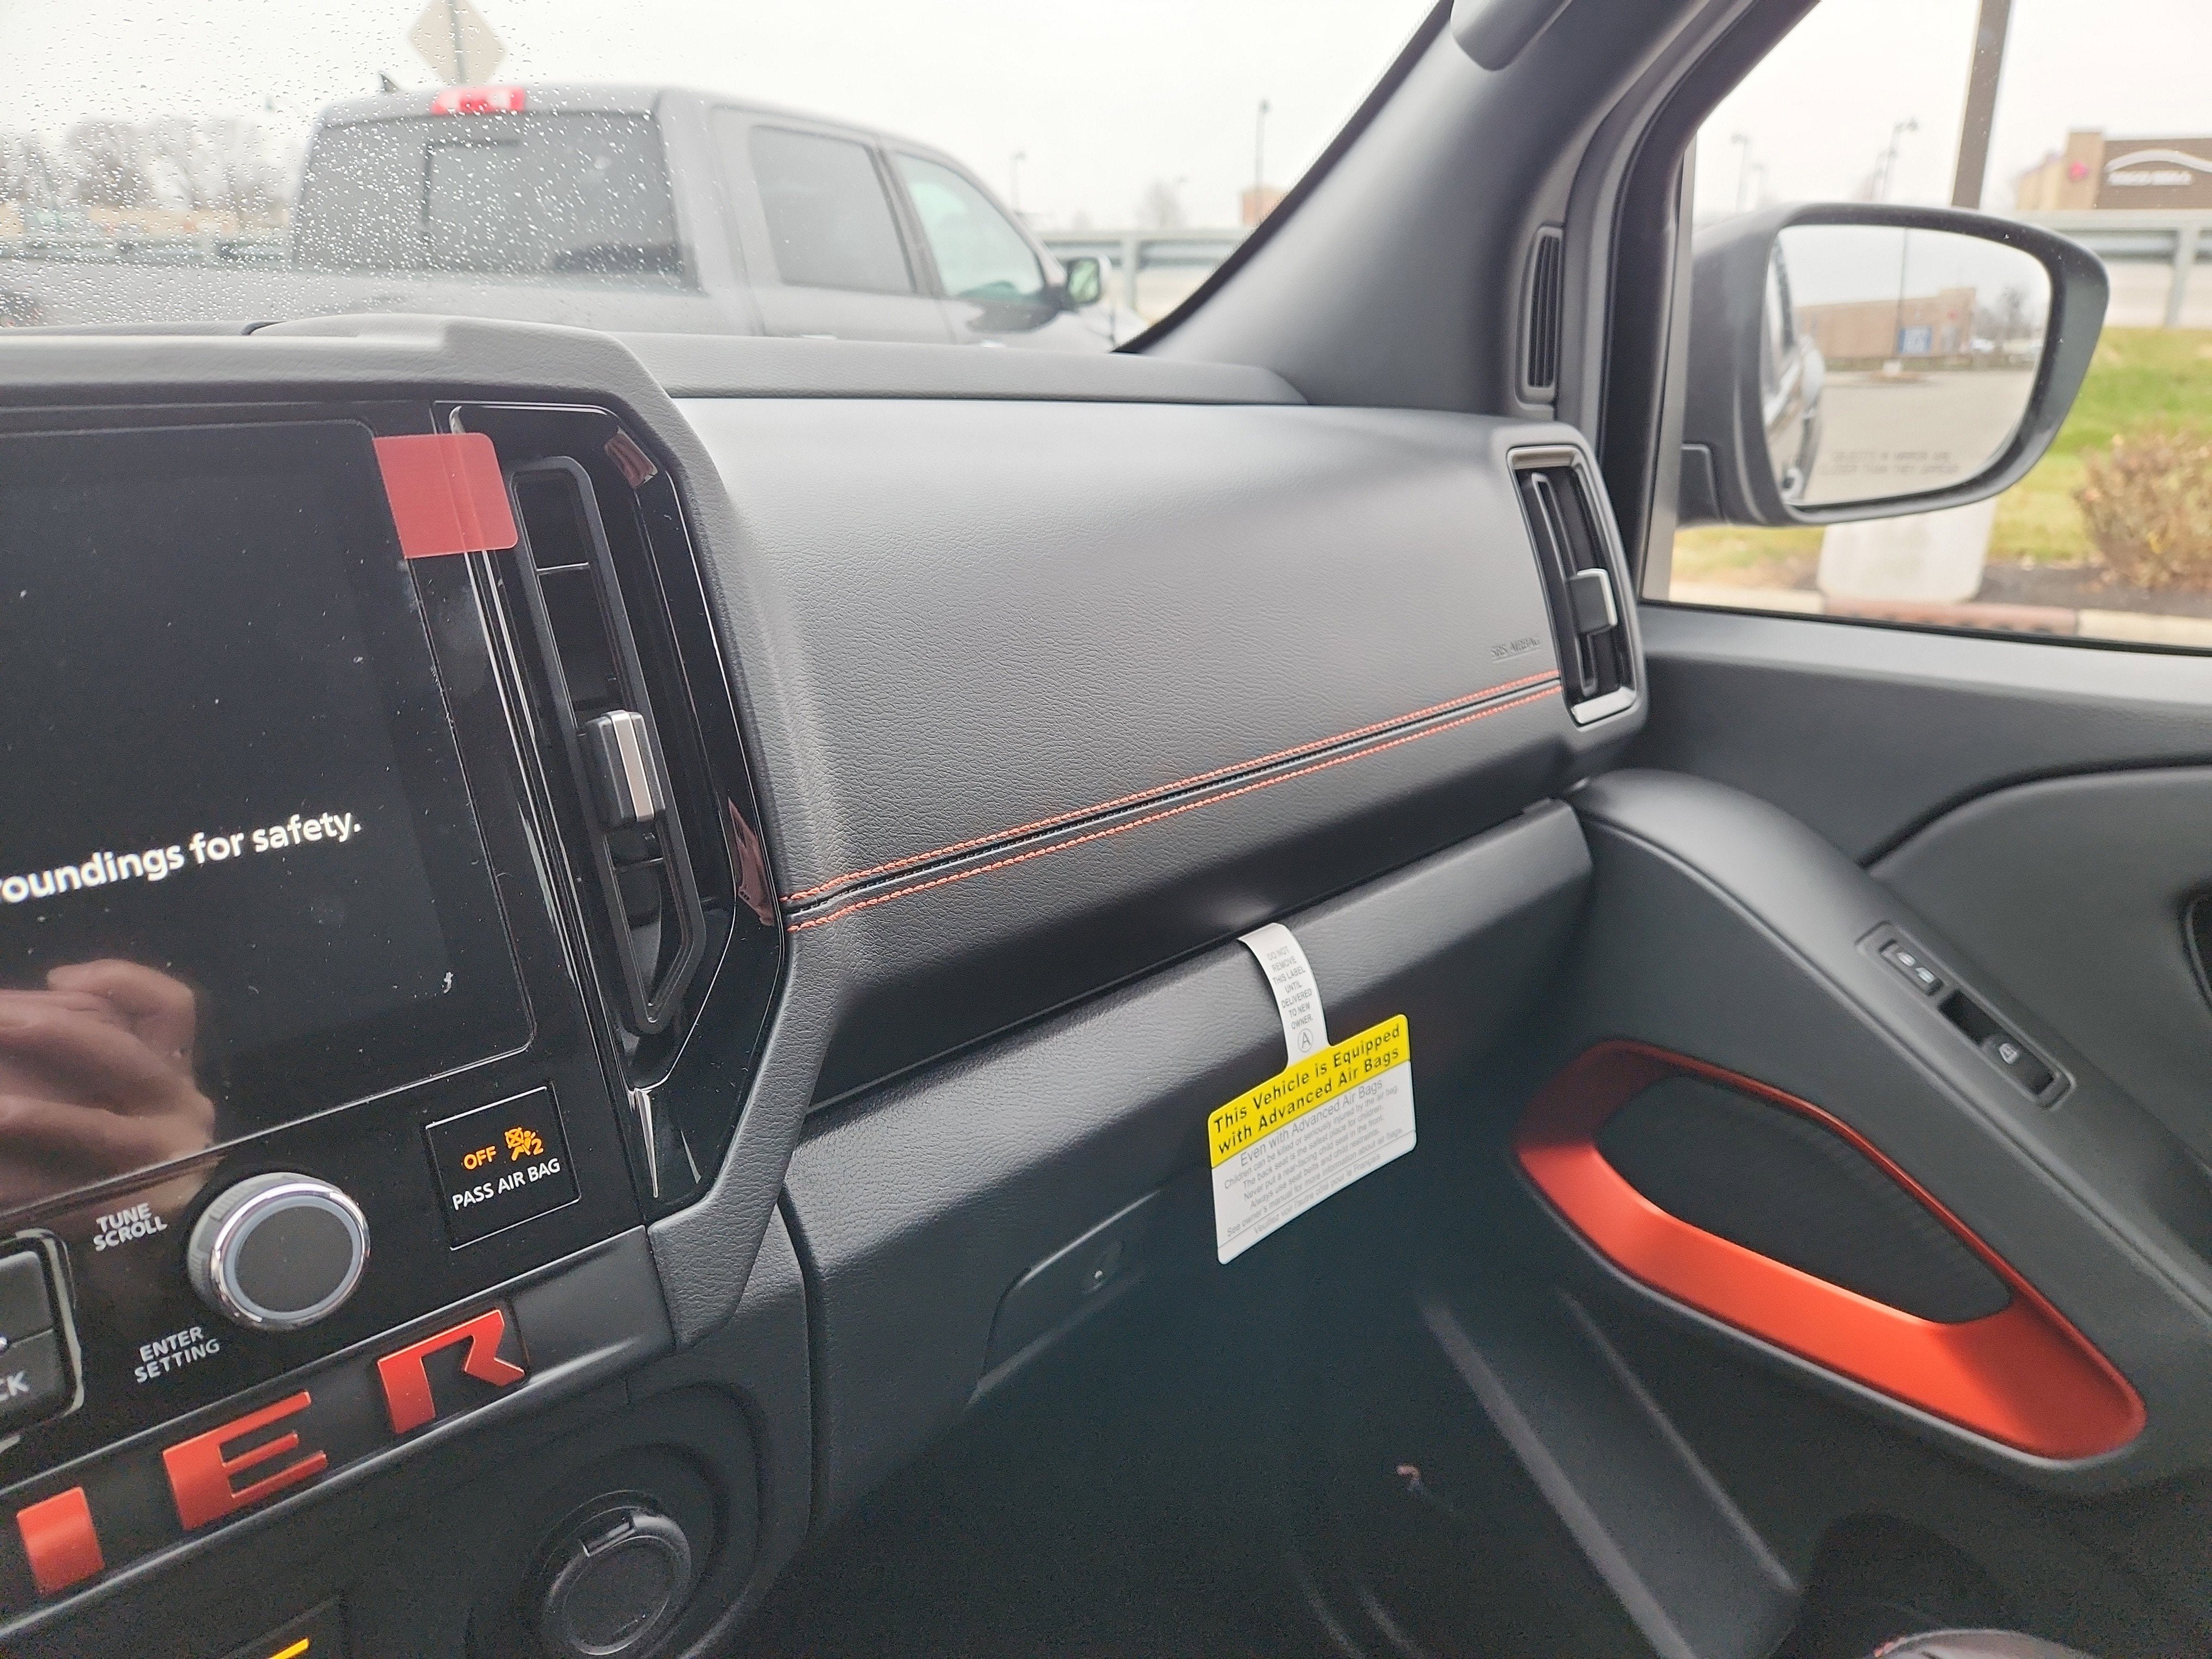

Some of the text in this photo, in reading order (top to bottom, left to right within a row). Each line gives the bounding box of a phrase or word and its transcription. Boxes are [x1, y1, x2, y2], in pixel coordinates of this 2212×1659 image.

[0, 812, 362, 903] oundings for safety.
[1271, 956, 1297, 972] REMOVE
[1276, 946, 1289, 958] NOT
[1272, 966, 1306, 985] THIS LABEL
[1284, 981, 1302, 993] UNTIL
[1281, 988, 1312, 1008] DELIVERED
[1289, 1002, 1310, 1018] TO NEW
[1291, 1014, 1313, 1030] OWNER.
[1214, 1024, 1399, 1133] This Vehicle is Equipped
[1219, 1049, 1399, 1154] with Advanced Air Bags
[1224, 1167, 1252, 1189] Children
[1253, 1159, 1265, 1171] can
[1267, 1153, 1275, 1162] be
[1295, 1136, 1302, 1146] or
[1304, 1121, 1332, 1141] seriously
[1333, 1108, 1354, 1124] injured
[1365, 1097, 1374, 1107] the
[1240, 1079, 1382, 1167] Even with Advanced Air Bags
[464, 1145, 497, 1170] OFF
[1243, 1177, 1256, 1189] The
[1257, 1167, 1273, 1181] back
[1275, 1156, 1288, 1170] seat
[1297, 1146, 1307, 1156] the
[1309, 1133, 1328, 1149] safest
[1329, 1124, 1346, 1139] place
[1348, 1118, 1356, 1127] for
[1244, 1184, 1263, 1199] Never
[1265, 1175, 1276, 1190] put
[1277, 1173, 1282, 1181] a
[1319, 1142, 1333, 1155] child
[1335, 1133, 1348, 1146] seat
[1357, 1123, 1367, 1133] the
[452, 1158, 561, 1211] PASS AIR BAG
[1227, 1223, 1240, 1237] See
[1269, 1190, 1293, 1208] manual
[1294, 1183, 1303, 1192] for
[1304, 1173, 1321, 1186] more
[1358, 1140, 1375, 1155] about
[1250, 1190, 1274, 1210] Always
[1275, 1181, 1287, 1194] use
[1288, 1172, 1302, 1185] seat
[1303, 1162, 1319, 1176] belts
[1321, 1154, 1332, 1166] and
[1334, 1145, 1348, 1158] child
[93, 1216, 168, 1252] SCROLL
[95, 1202, 152, 1233] TUNE
[134, 1338, 221, 1384] SETTING
[139, 1326, 204, 1362] ENTER
